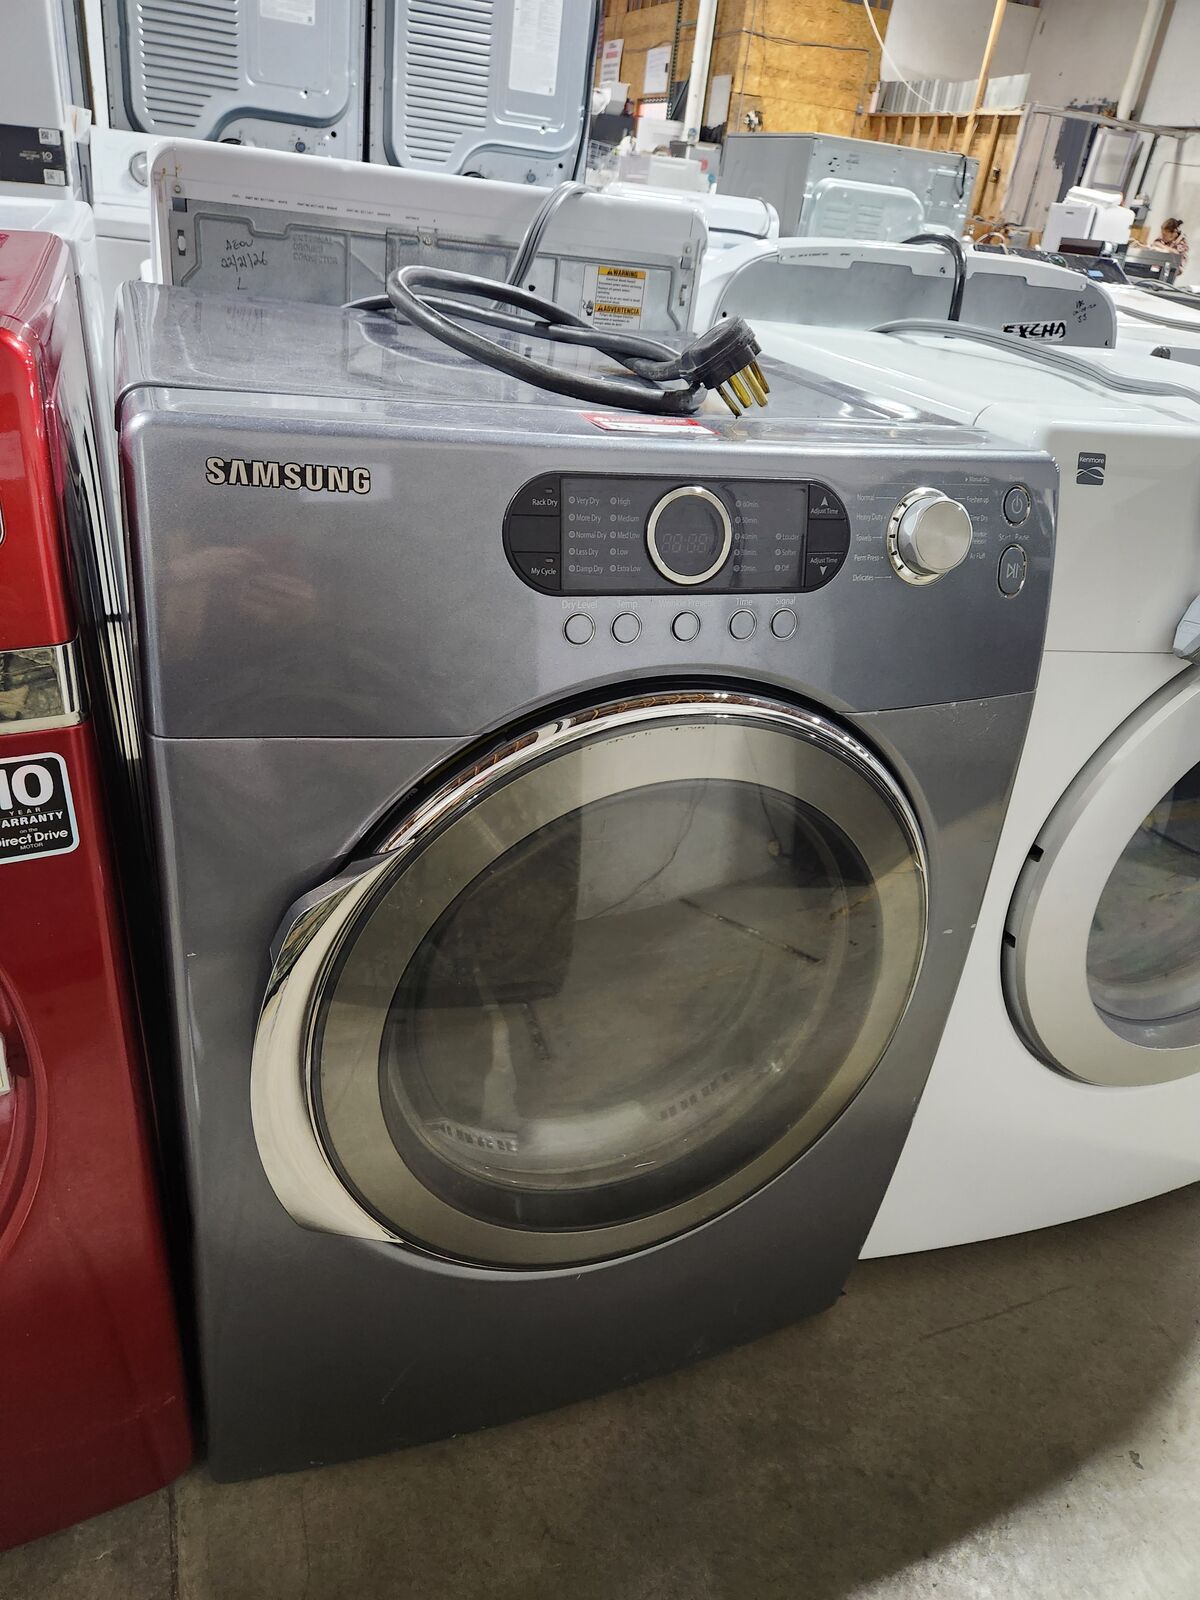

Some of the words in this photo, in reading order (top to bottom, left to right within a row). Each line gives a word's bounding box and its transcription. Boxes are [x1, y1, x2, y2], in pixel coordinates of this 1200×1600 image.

[604, 305, 640, 316] ADVERTENCIA
[1079, 456, 1105, 464] Kenmore
[205, 456, 371, 494] SAMSUNG
[548, 499, 558, 507] Dry
[576, 497, 588, 506] Very
[589, 497, 600, 506] Dry
[617, 498, 631, 507] High
[810, 507, 826, 516] Adjust
[591, 514, 601, 523] Dry
[856, 513, 871, 522] Heavy
[576, 530, 596, 538] Normal
[597, 531, 607, 540] Dry
[617, 531, 629, 539] Med
[630, 531, 641, 539] Low
[856, 534, 872, 542] Towels
[576, 547, 587, 555] Less
[588, 547, 599, 557] Dry
[810, 557, 825, 566] Adjust
[531, 567, 540, 575] My
[541, 567, 556, 575] Cycle
[576, 564, 592, 573] Damp
[593, 564, 604, 574] Dry
[562, 600, 575, 610] Dry
[577, 600, 598, 608] Level
[736, 597, 753, 606] Time
[775, 596, 795, 606] Signal
[0, 764, 54, 810] 10
[9, 807, 41, 816] YEAR
[1, 811, 63, 828] ARRANTY
[0, 833, 32, 847] irect
[34, 829, 68, 841] Drive
